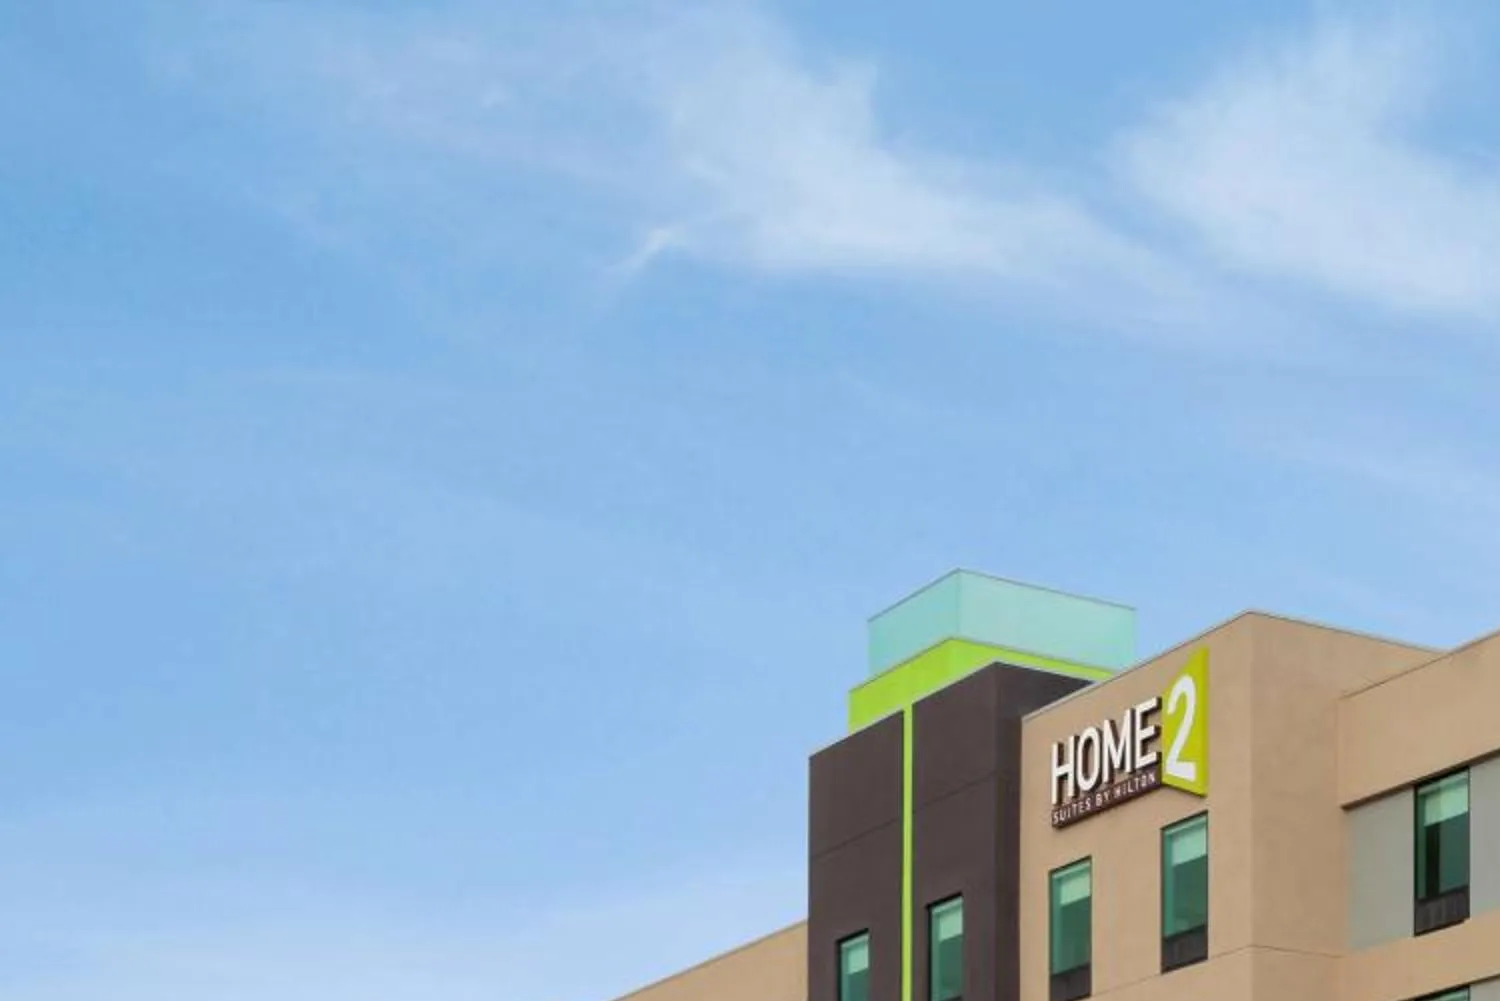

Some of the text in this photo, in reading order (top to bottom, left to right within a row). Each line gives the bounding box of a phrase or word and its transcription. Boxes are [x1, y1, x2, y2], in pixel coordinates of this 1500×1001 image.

[1052, 674, 1197, 805] HOME 2
[1053, 771, 1157, 825] SUITES BY HILTON
